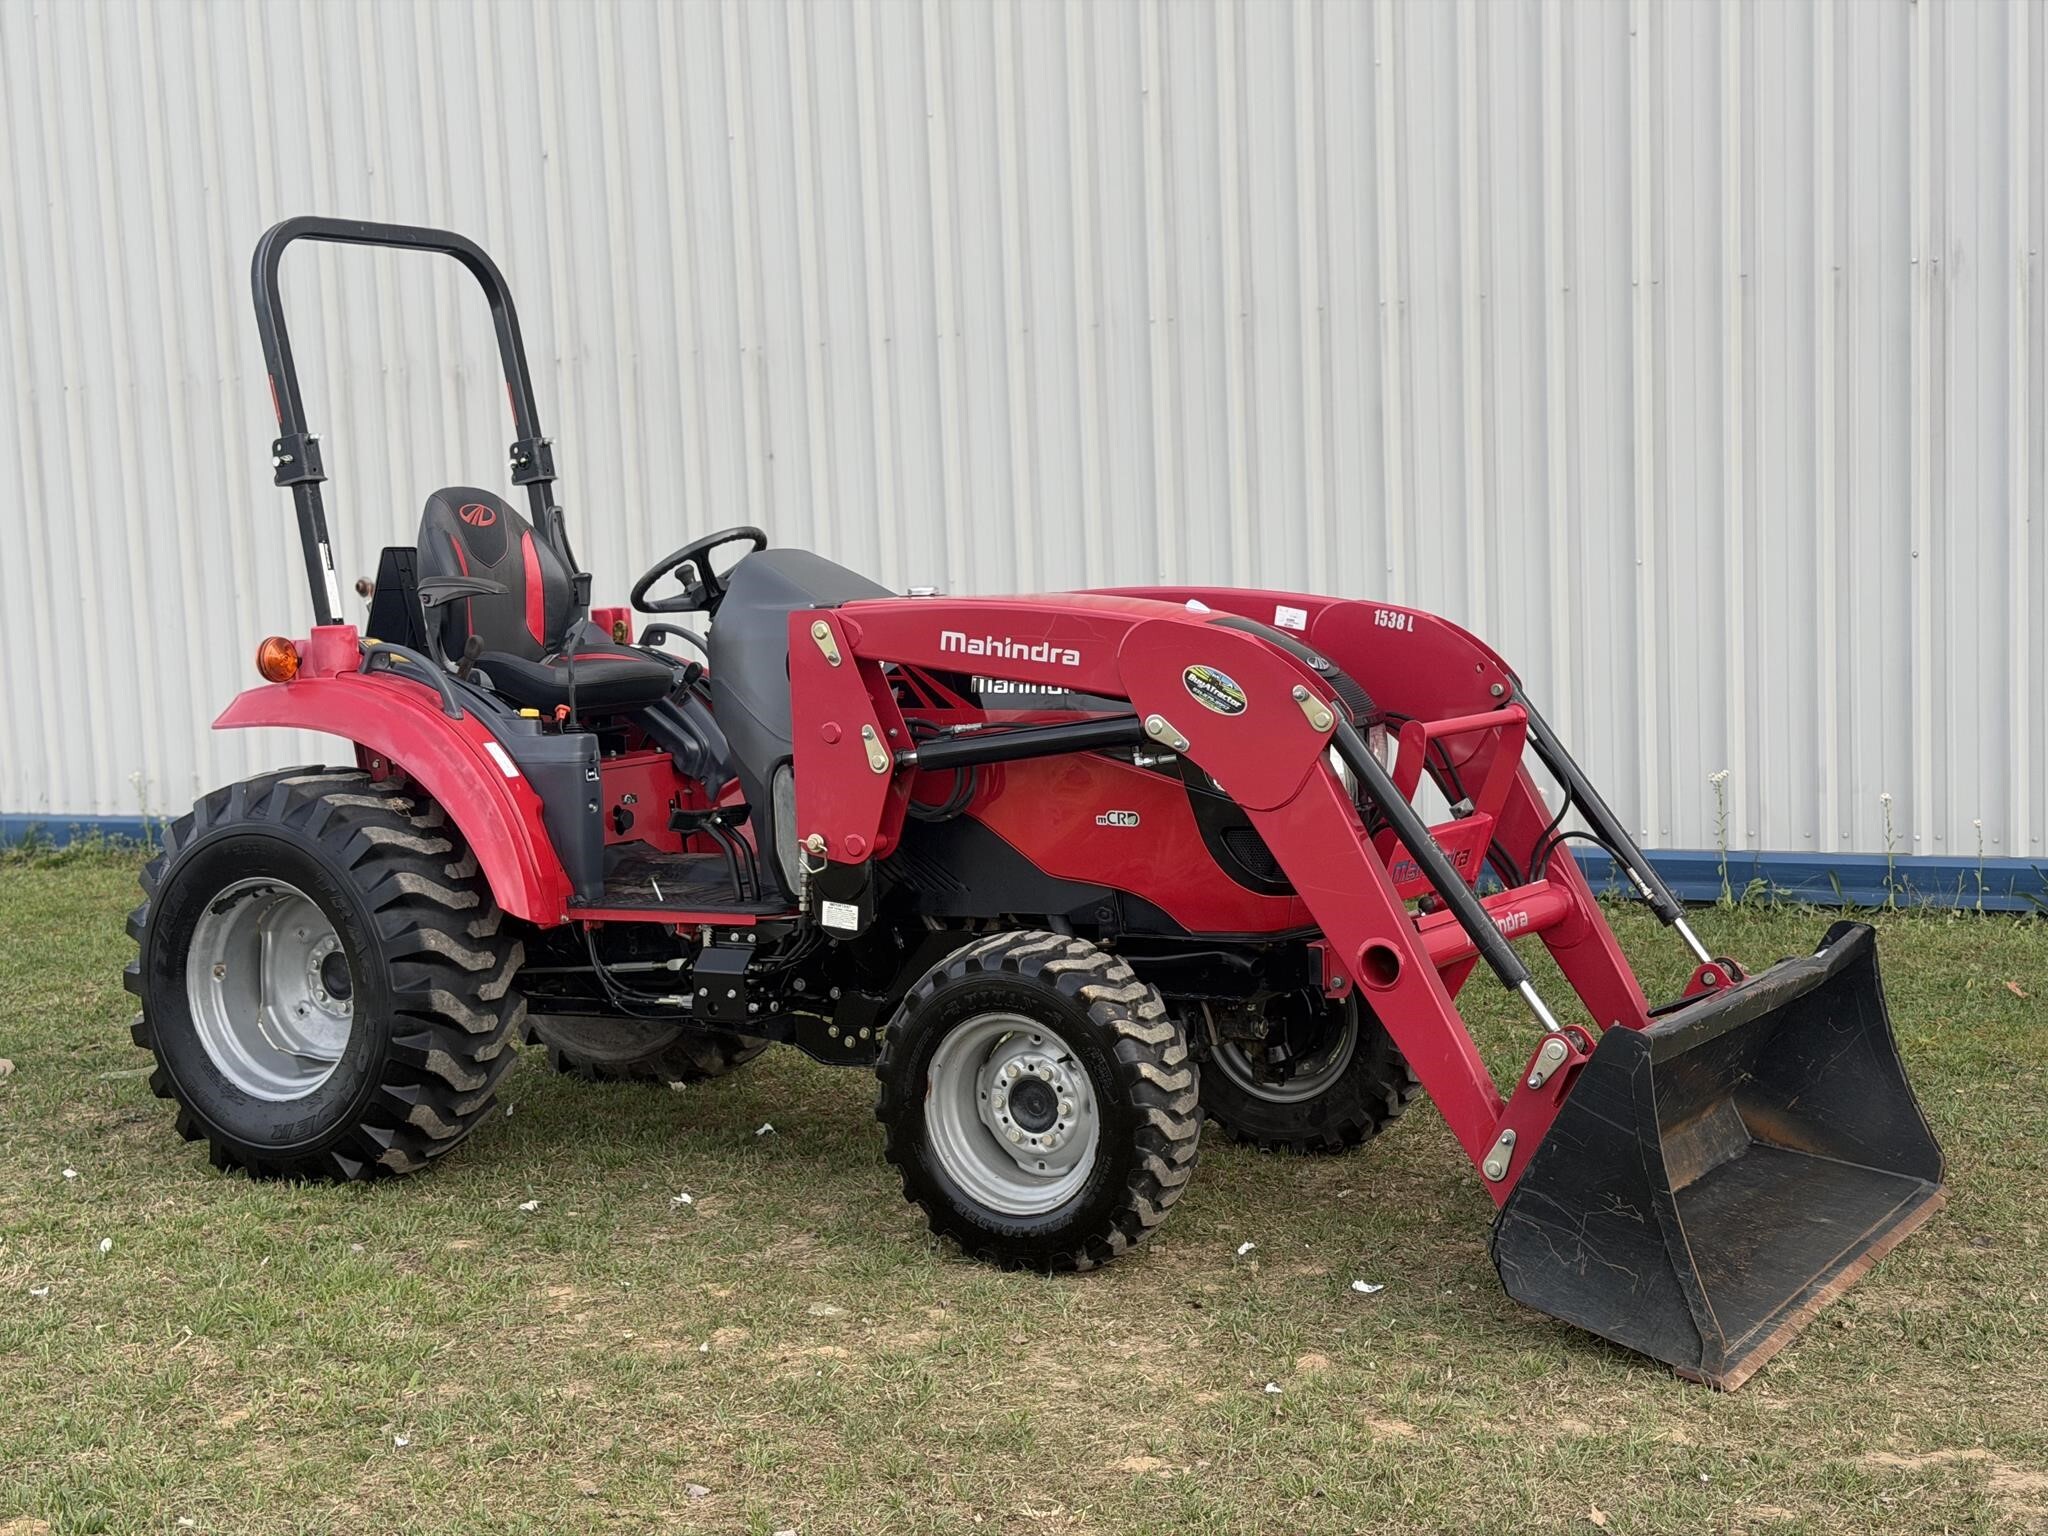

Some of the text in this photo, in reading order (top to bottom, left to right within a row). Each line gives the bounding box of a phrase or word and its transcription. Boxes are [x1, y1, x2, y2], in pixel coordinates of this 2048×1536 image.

[1374, 609, 1414, 633] 1538 L
[940, 631, 1081, 666] Mahindra
